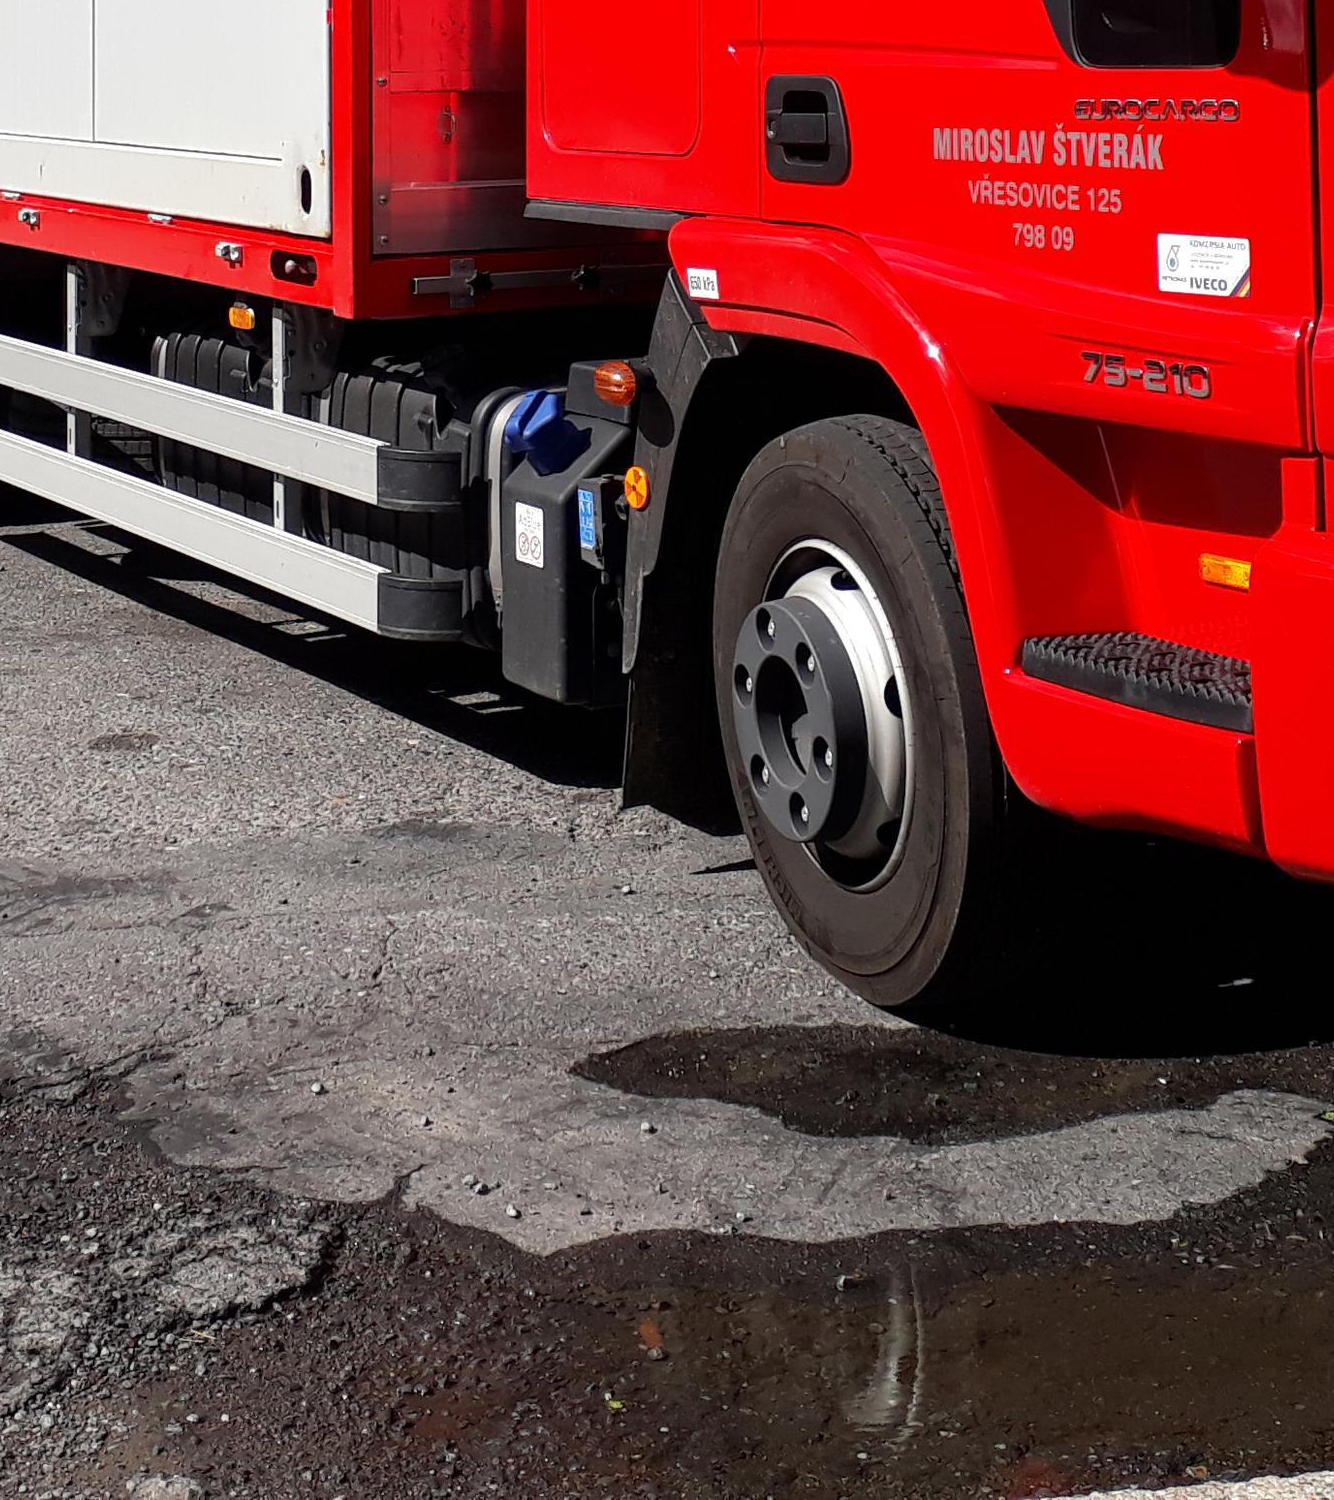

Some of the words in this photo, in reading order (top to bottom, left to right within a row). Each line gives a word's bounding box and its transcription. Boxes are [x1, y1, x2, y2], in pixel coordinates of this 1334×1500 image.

[1073, 98, 1240, 122] EUROCARGO
[933, 127, 1045, 165] MIROSLAV
[1053, 122, 1164, 170] ŠTVERÁK
[968, 173, 1080, 210] VŘESOVICE
[1086, 188, 1122, 213] 125
[1012, 223, 1045, 249] 798
[1051, 226, 1075, 251] 09
[1190, 277, 1227, 291] IVECO
[1081, 350, 1211, 398] 75-210
